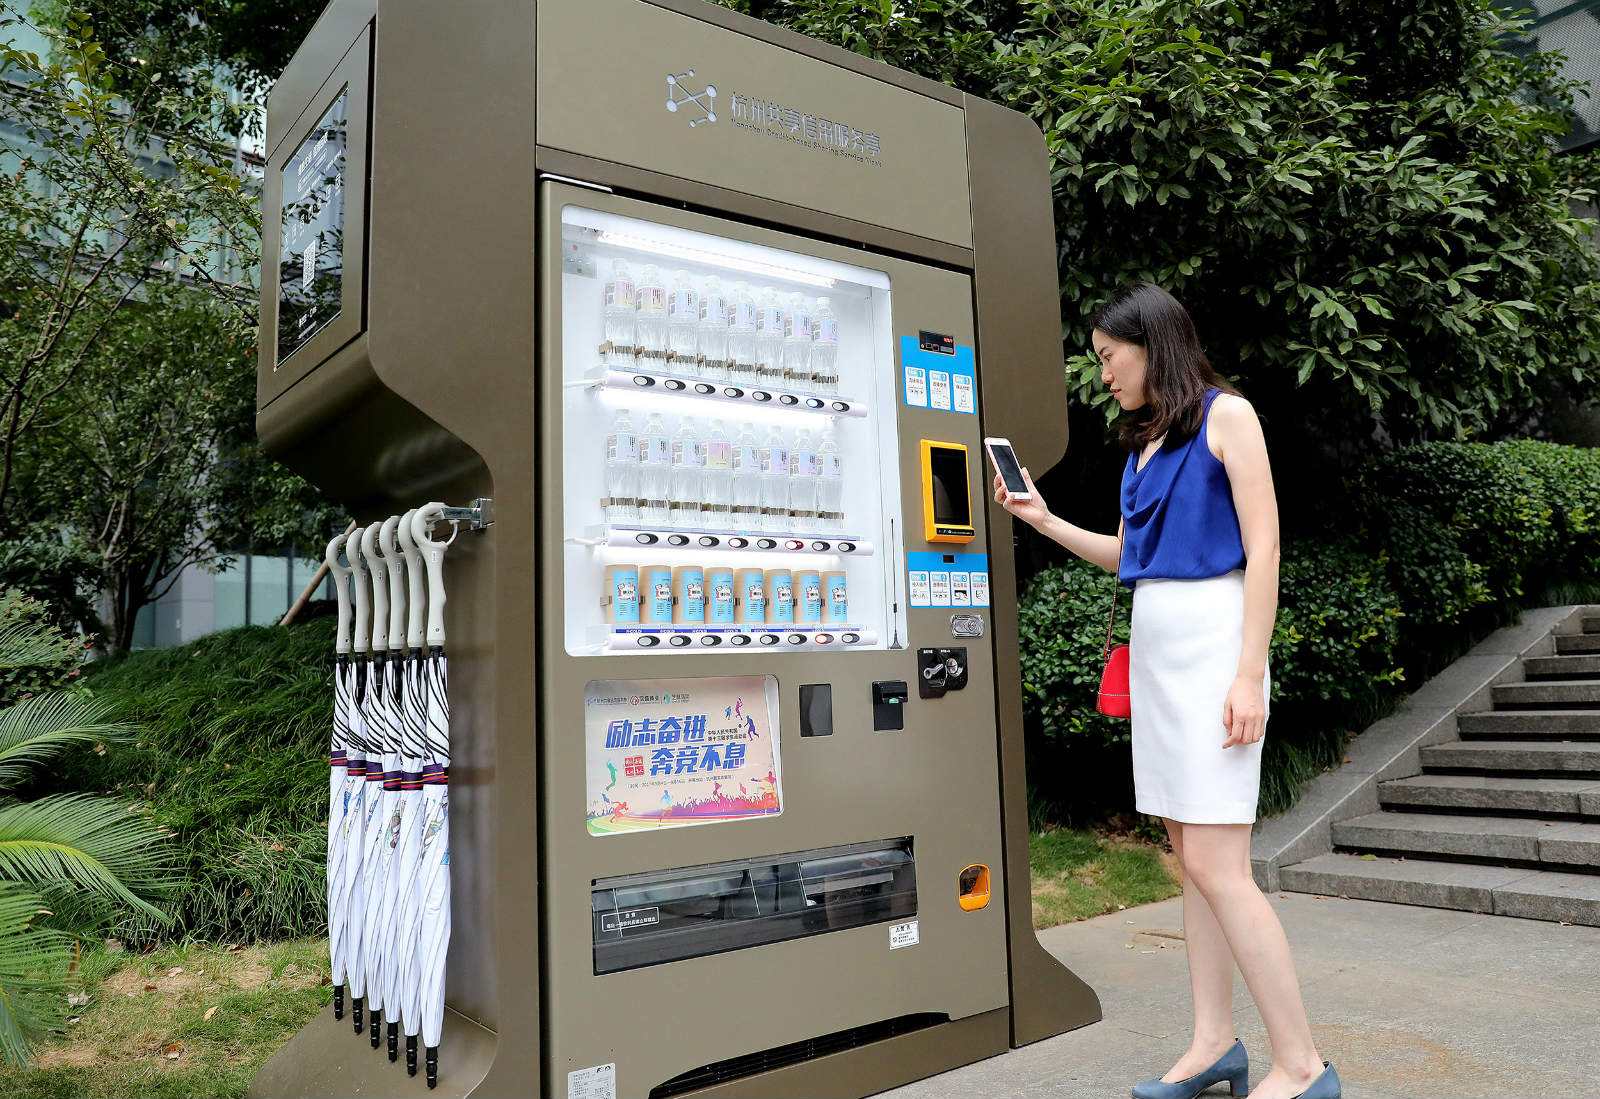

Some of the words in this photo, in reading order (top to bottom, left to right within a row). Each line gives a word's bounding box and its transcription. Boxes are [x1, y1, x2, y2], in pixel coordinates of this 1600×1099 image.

[730, 91, 881, 156] 杭州共享信用服务亭
[605, 714, 707, 749] 励志奋进
[649, 742, 746, 776] 奔竞不息
